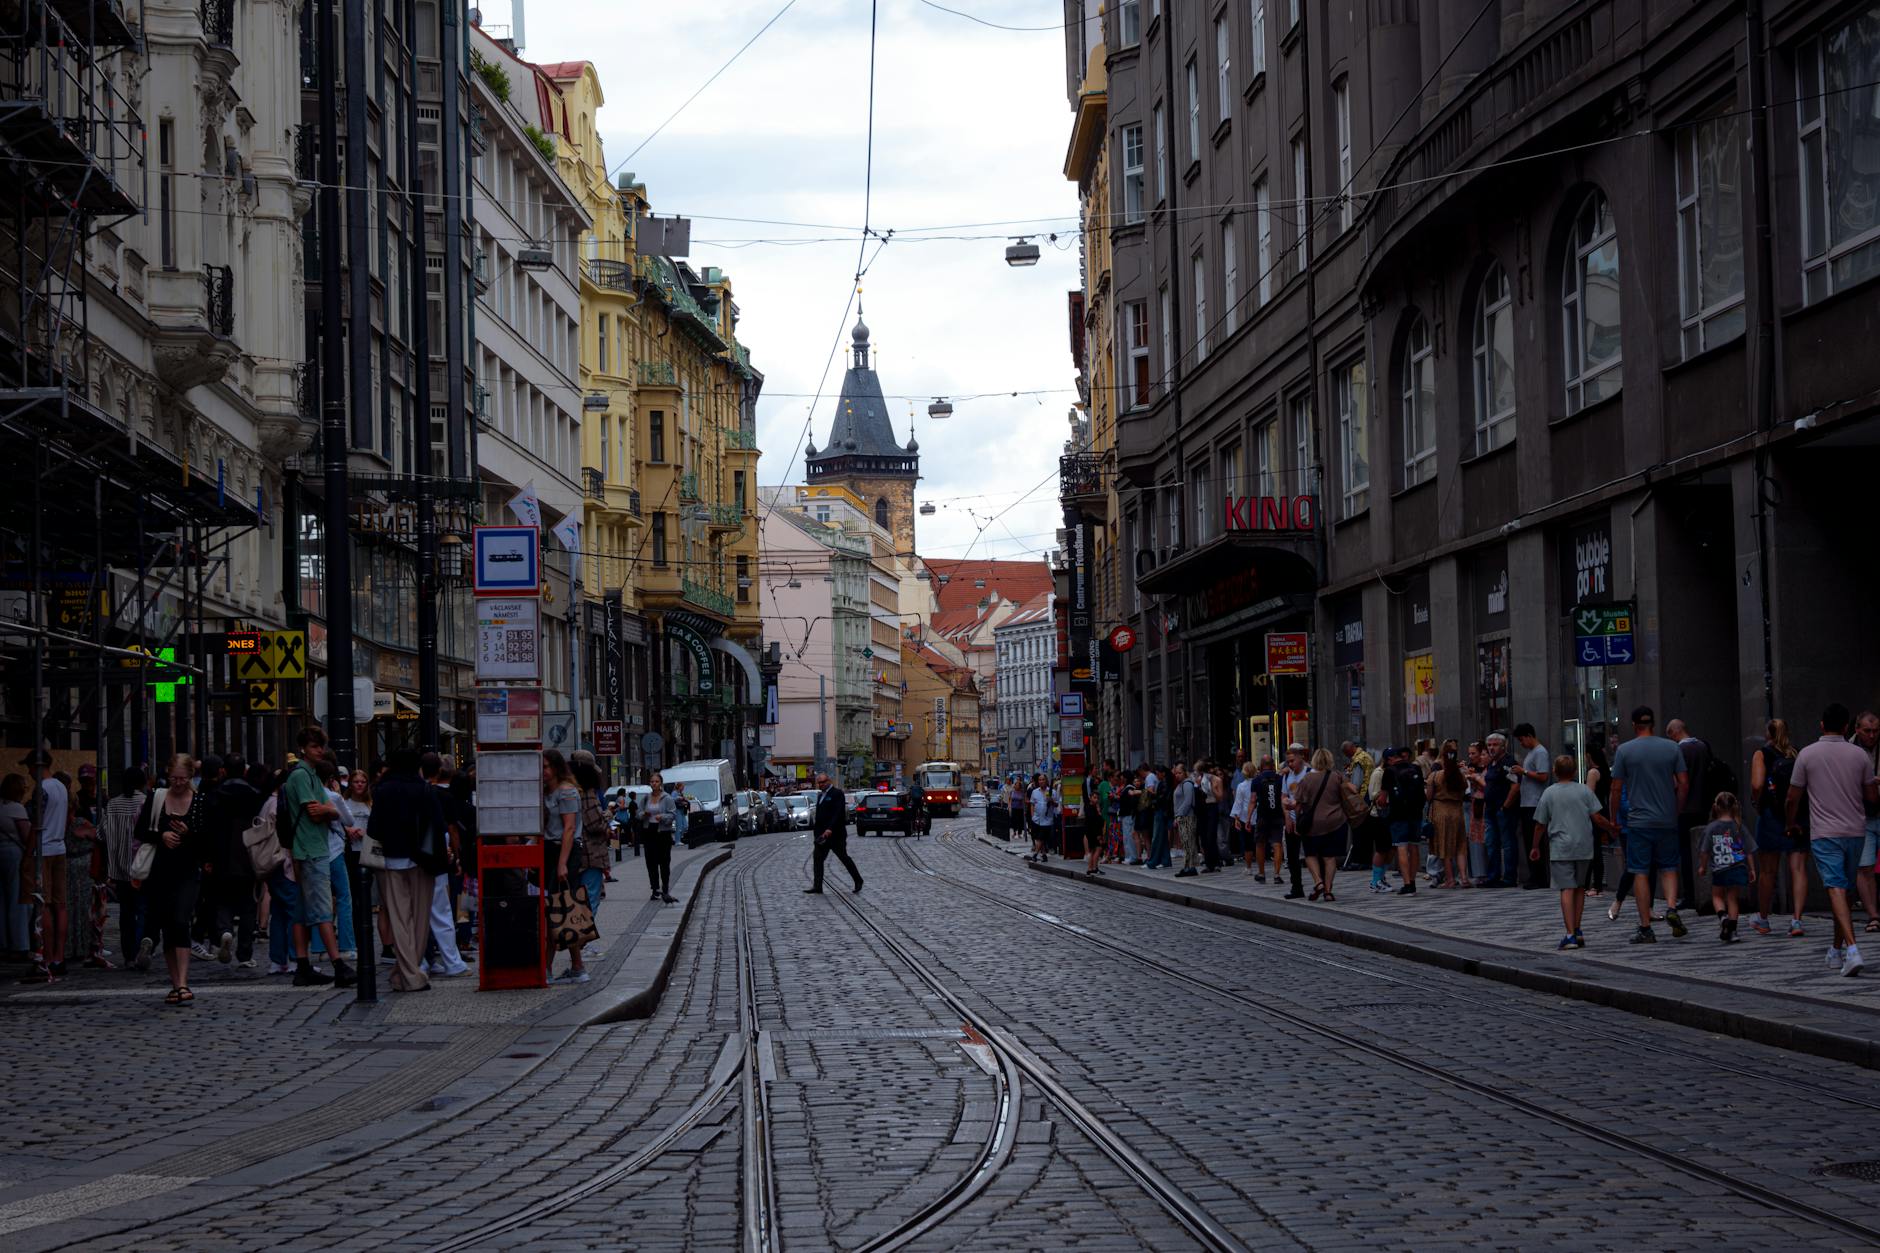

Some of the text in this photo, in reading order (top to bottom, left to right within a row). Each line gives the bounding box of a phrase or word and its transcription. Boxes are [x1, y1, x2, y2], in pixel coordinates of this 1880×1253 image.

[1224, 496, 1314, 530] KINO
[1575, 530, 1609, 571] bubble
[490, 603, 522, 611] VÁCLAVSKÉ
[1607, 620, 1627, 630] A B
[482, 631, 533, 641] 3 9 91 95
[483, 642, 533, 652] 5 14 92 96
[666, 625, 710, 675] TEA & COFFEE
[483, 652, 534, 662] 6 24 94 98
[596, 725, 620, 733] NAILS
[1267, 784, 1276, 809] adidas
